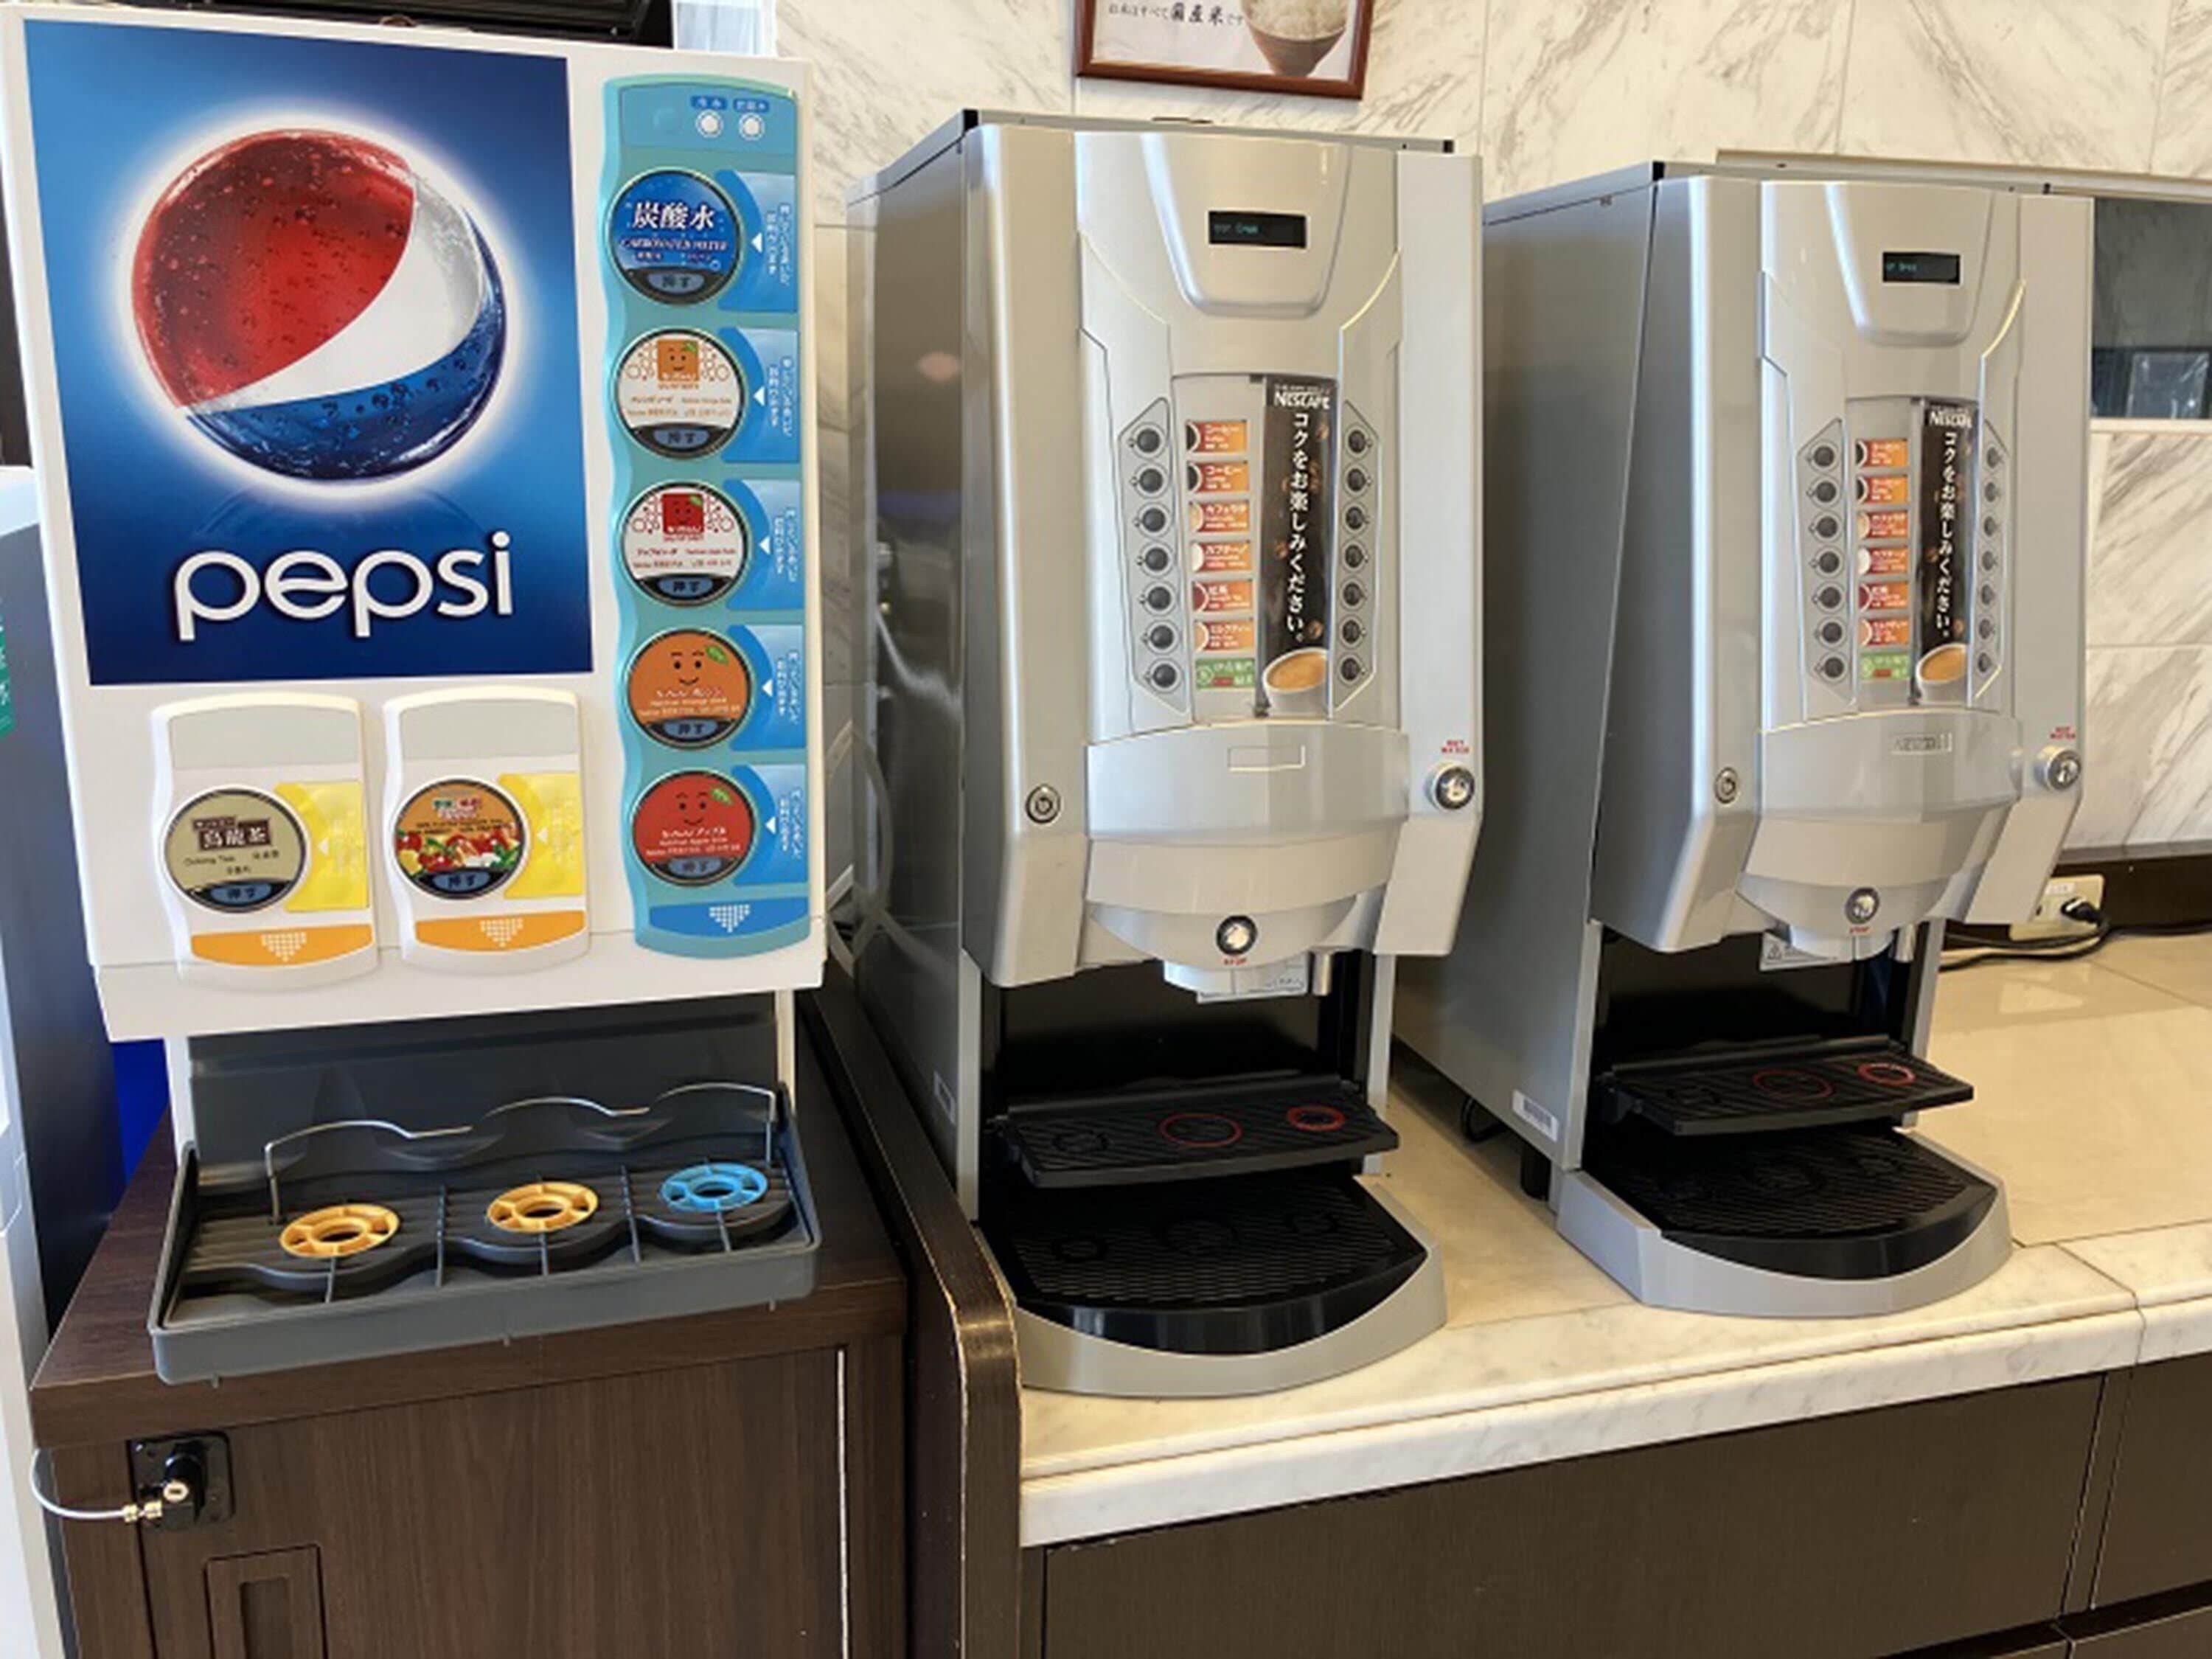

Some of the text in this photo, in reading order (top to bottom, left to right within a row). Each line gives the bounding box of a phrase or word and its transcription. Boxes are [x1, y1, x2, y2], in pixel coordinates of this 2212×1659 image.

[633, 201, 715, 232] 炭酸水
[174, 531, 514, 641] pepsi
